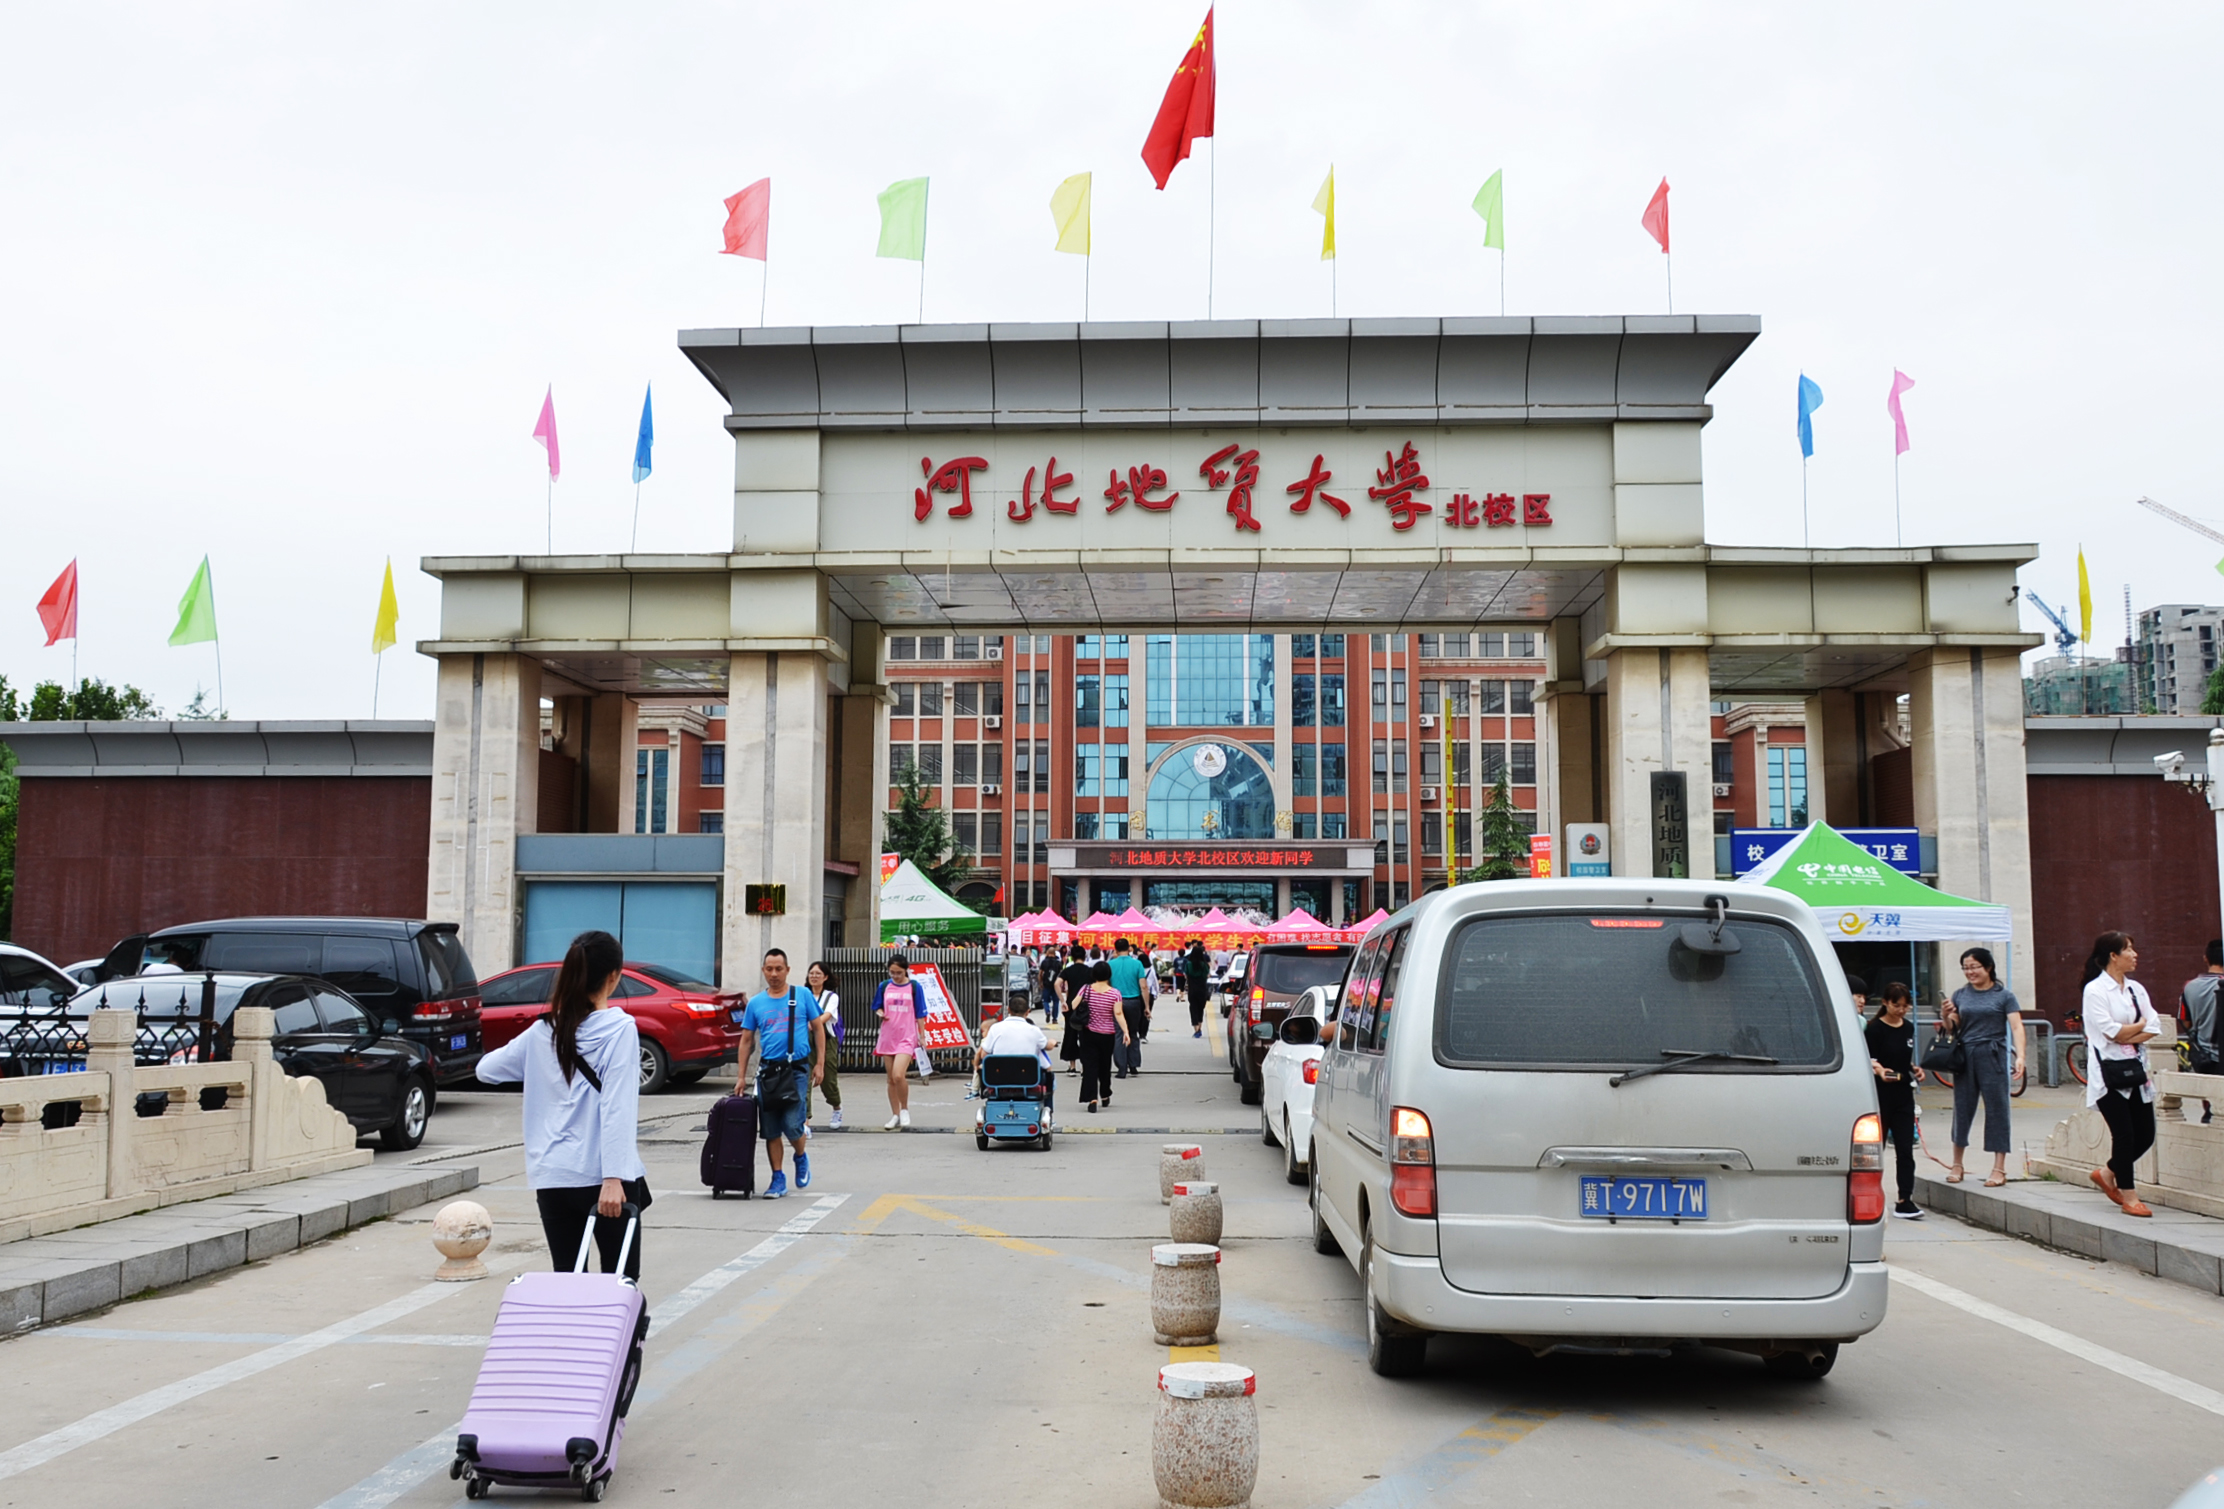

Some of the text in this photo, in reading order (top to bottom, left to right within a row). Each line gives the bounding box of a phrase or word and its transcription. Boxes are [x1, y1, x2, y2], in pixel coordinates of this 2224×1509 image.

[1445, 493, 1553, 526] 北校区
[1109, 850, 1314, 866] 河北地质大学北校区欢迎新同学
[1823, 862, 1880, 875] 中国电信
[904, 894, 926, 902] 4G
[898, 920, 950, 933] 用心服务
[1868, 912, 1901, 927] 天翼
